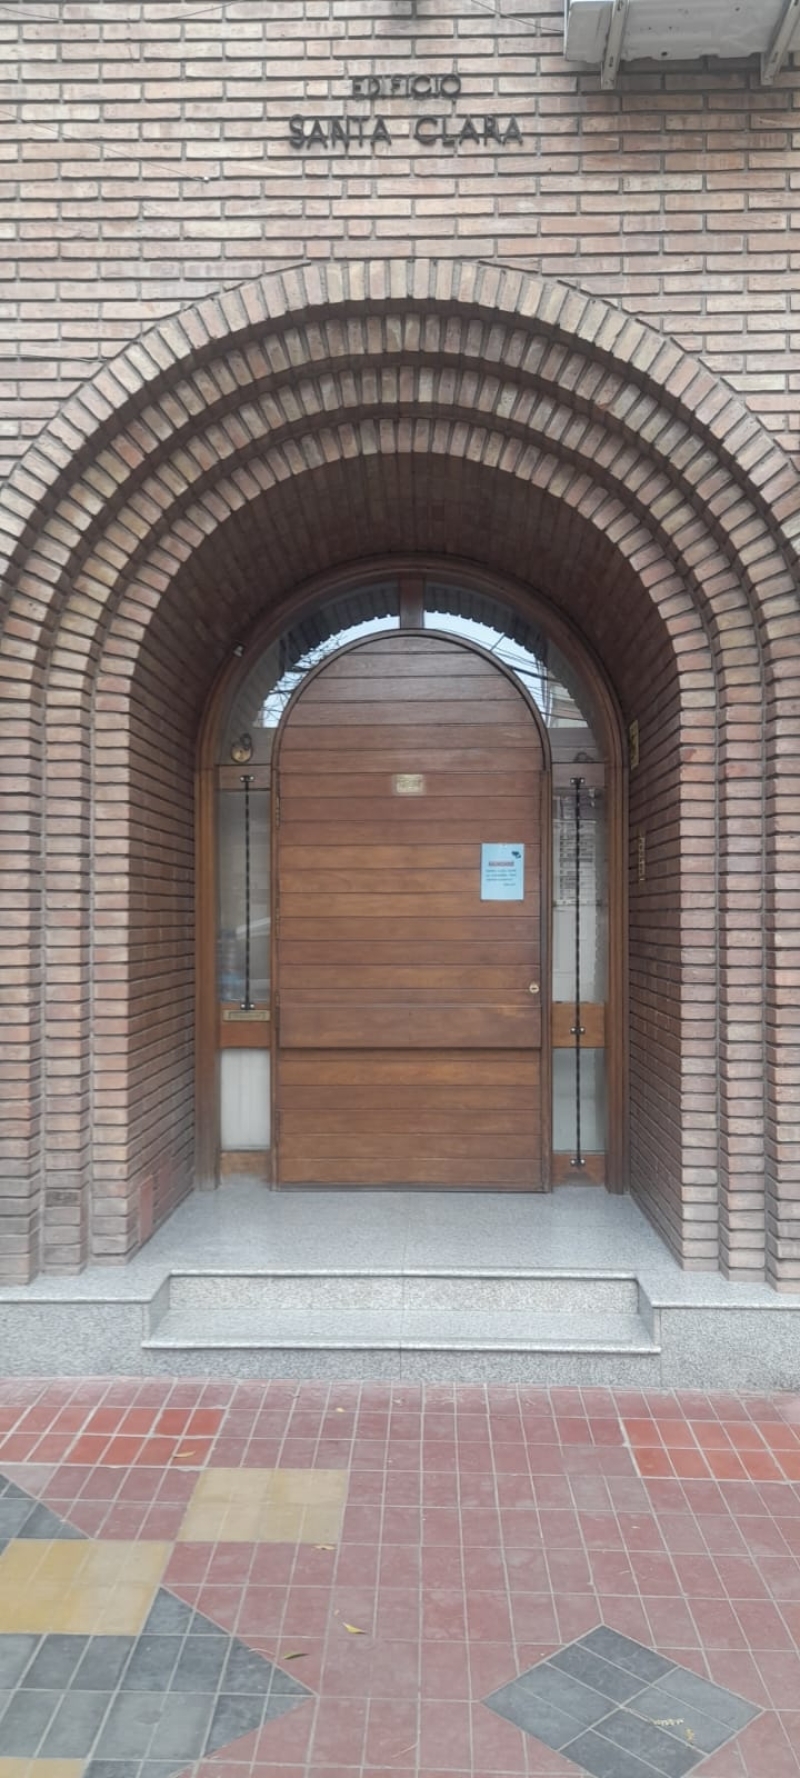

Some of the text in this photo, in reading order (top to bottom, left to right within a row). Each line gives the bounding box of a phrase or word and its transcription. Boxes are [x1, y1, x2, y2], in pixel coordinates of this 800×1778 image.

[352, 75, 461, 99] EDIFICIO
[289, 114, 523, 149] SANTA CLARA
